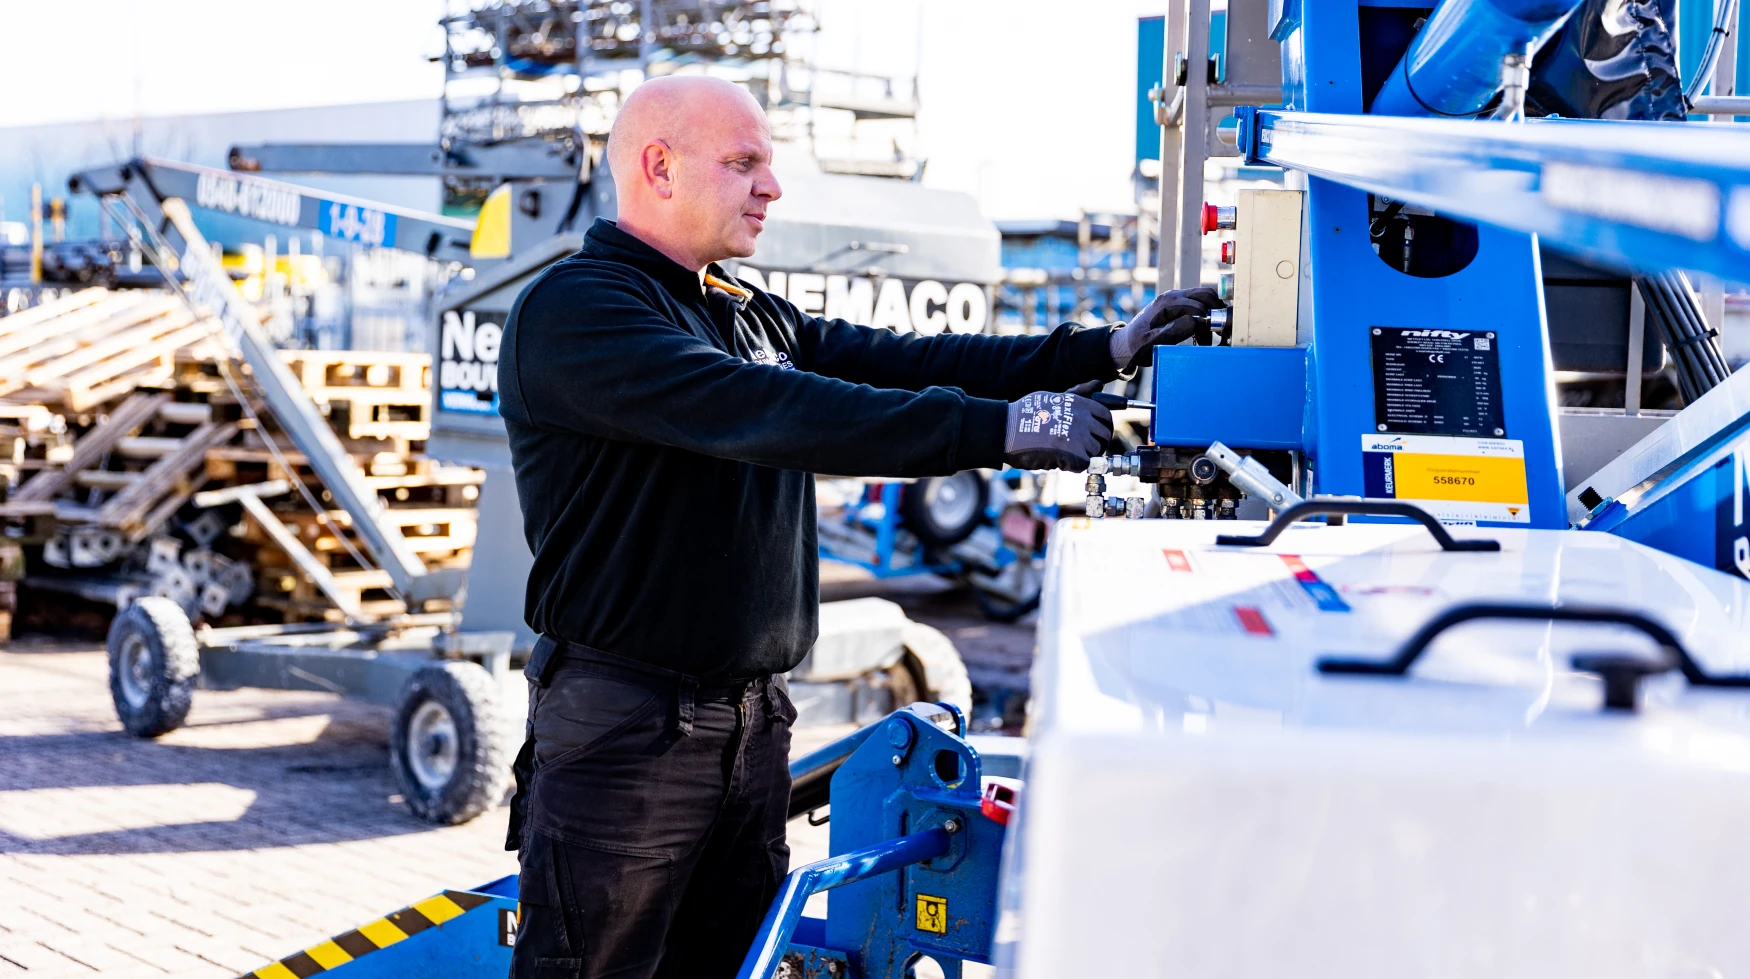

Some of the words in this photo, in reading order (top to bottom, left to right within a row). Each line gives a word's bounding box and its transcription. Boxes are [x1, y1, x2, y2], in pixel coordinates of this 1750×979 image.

[737, 265, 987, 336] NEMACO
[1401, 330, 1470, 339] nifty
[1061, 394, 1074, 437] MaxiFlex
[1372, 443, 1403, 451] aboma
[1384, 457, 1394, 494] KEURMERK
[1433, 476, 1475, 486] 558670
